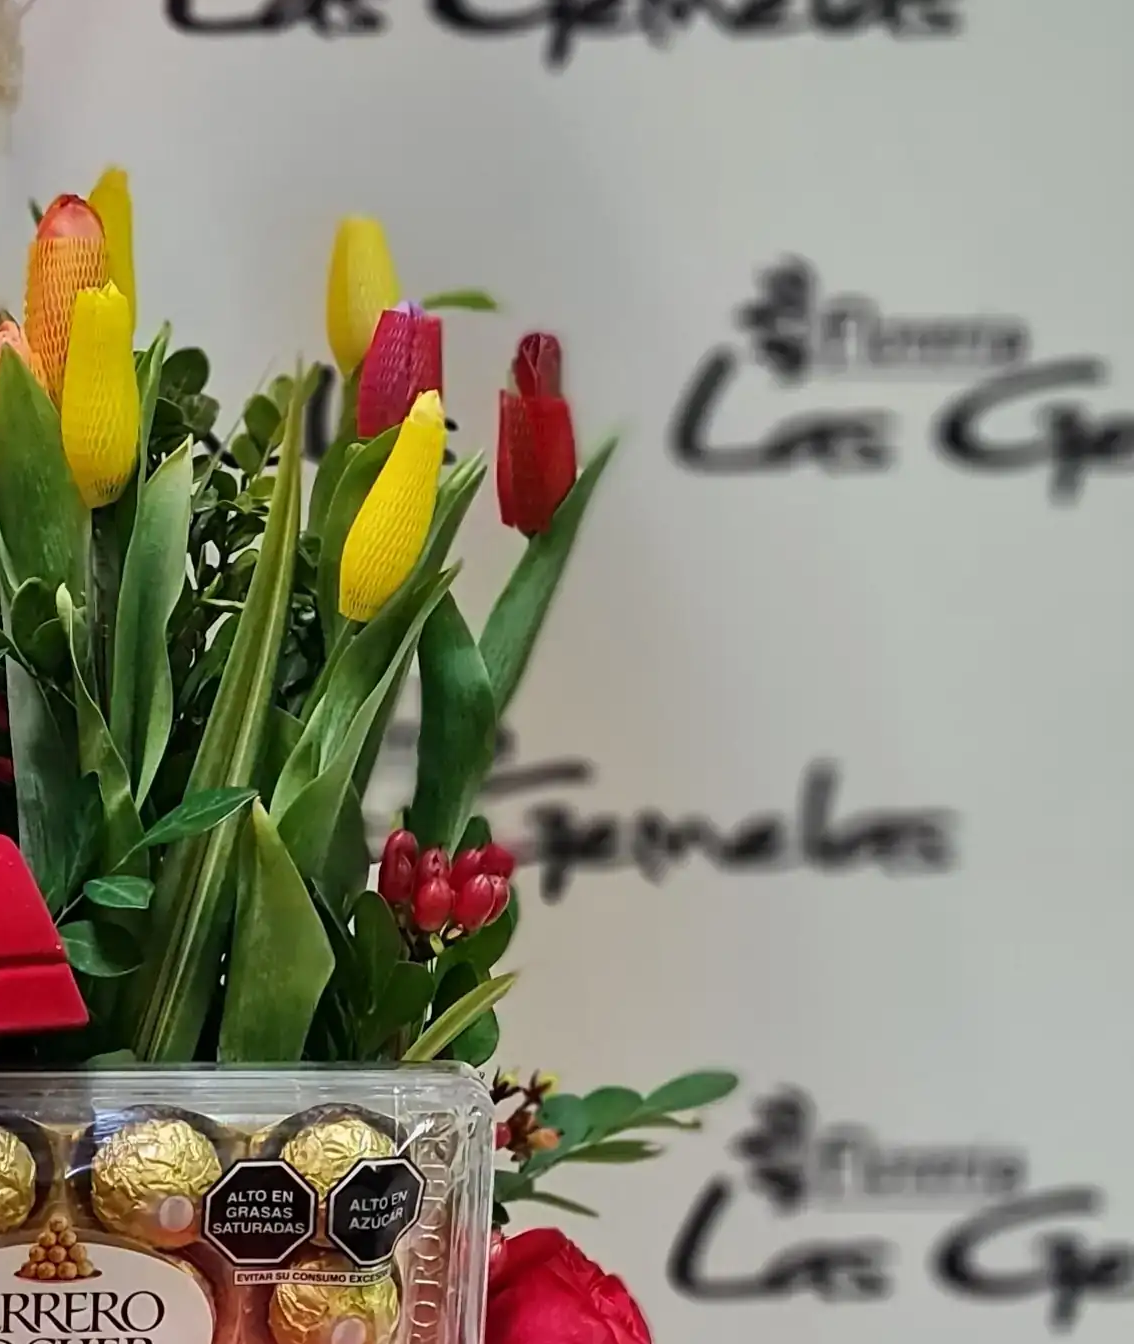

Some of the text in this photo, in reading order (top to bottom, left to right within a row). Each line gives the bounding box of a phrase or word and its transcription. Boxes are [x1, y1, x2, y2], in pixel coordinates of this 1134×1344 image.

[227, 1189, 293, 1204] ALTO EN
[349, 1190, 408, 1212] ALTO EN
[225, 1206, 293, 1219] GRASAS
[349, 1206, 404, 1230] AZÚCAR
[212, 1222, 306, 1235] SATURADAS
[236, 1272, 274, 1283] EVITAR
[275, 1271, 291, 1281] SU
[292, 1272, 347, 1283] CONSUMO
